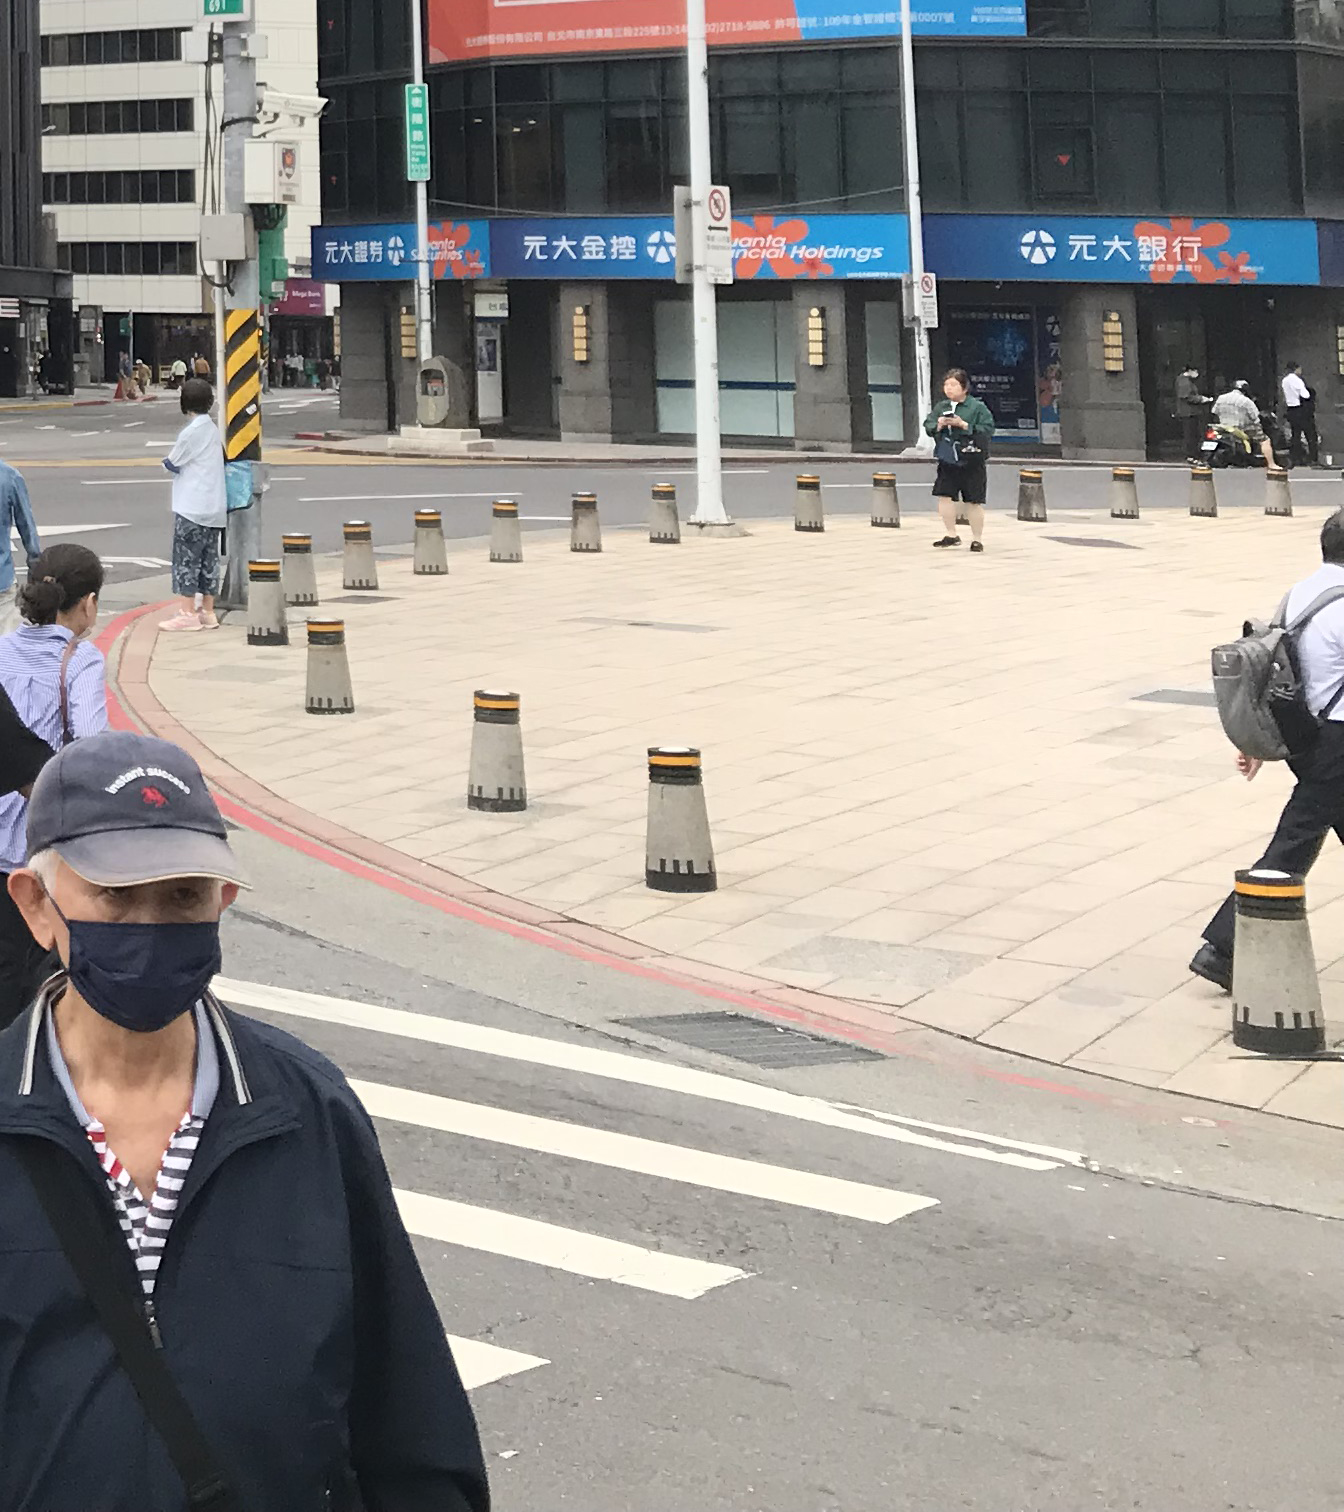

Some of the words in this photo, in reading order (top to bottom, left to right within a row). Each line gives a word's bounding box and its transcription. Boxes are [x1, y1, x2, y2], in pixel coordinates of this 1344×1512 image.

[325, 240, 383, 263] 元大證券
[523, 235, 637, 261] 元大金控
[732, 235, 787, 248] uanta
[790, 244, 884, 263] Holdings
[1068, 234, 1203, 262] 元大銀行
[104, 766, 146, 795] instant
[146, 766, 191, 795] success
